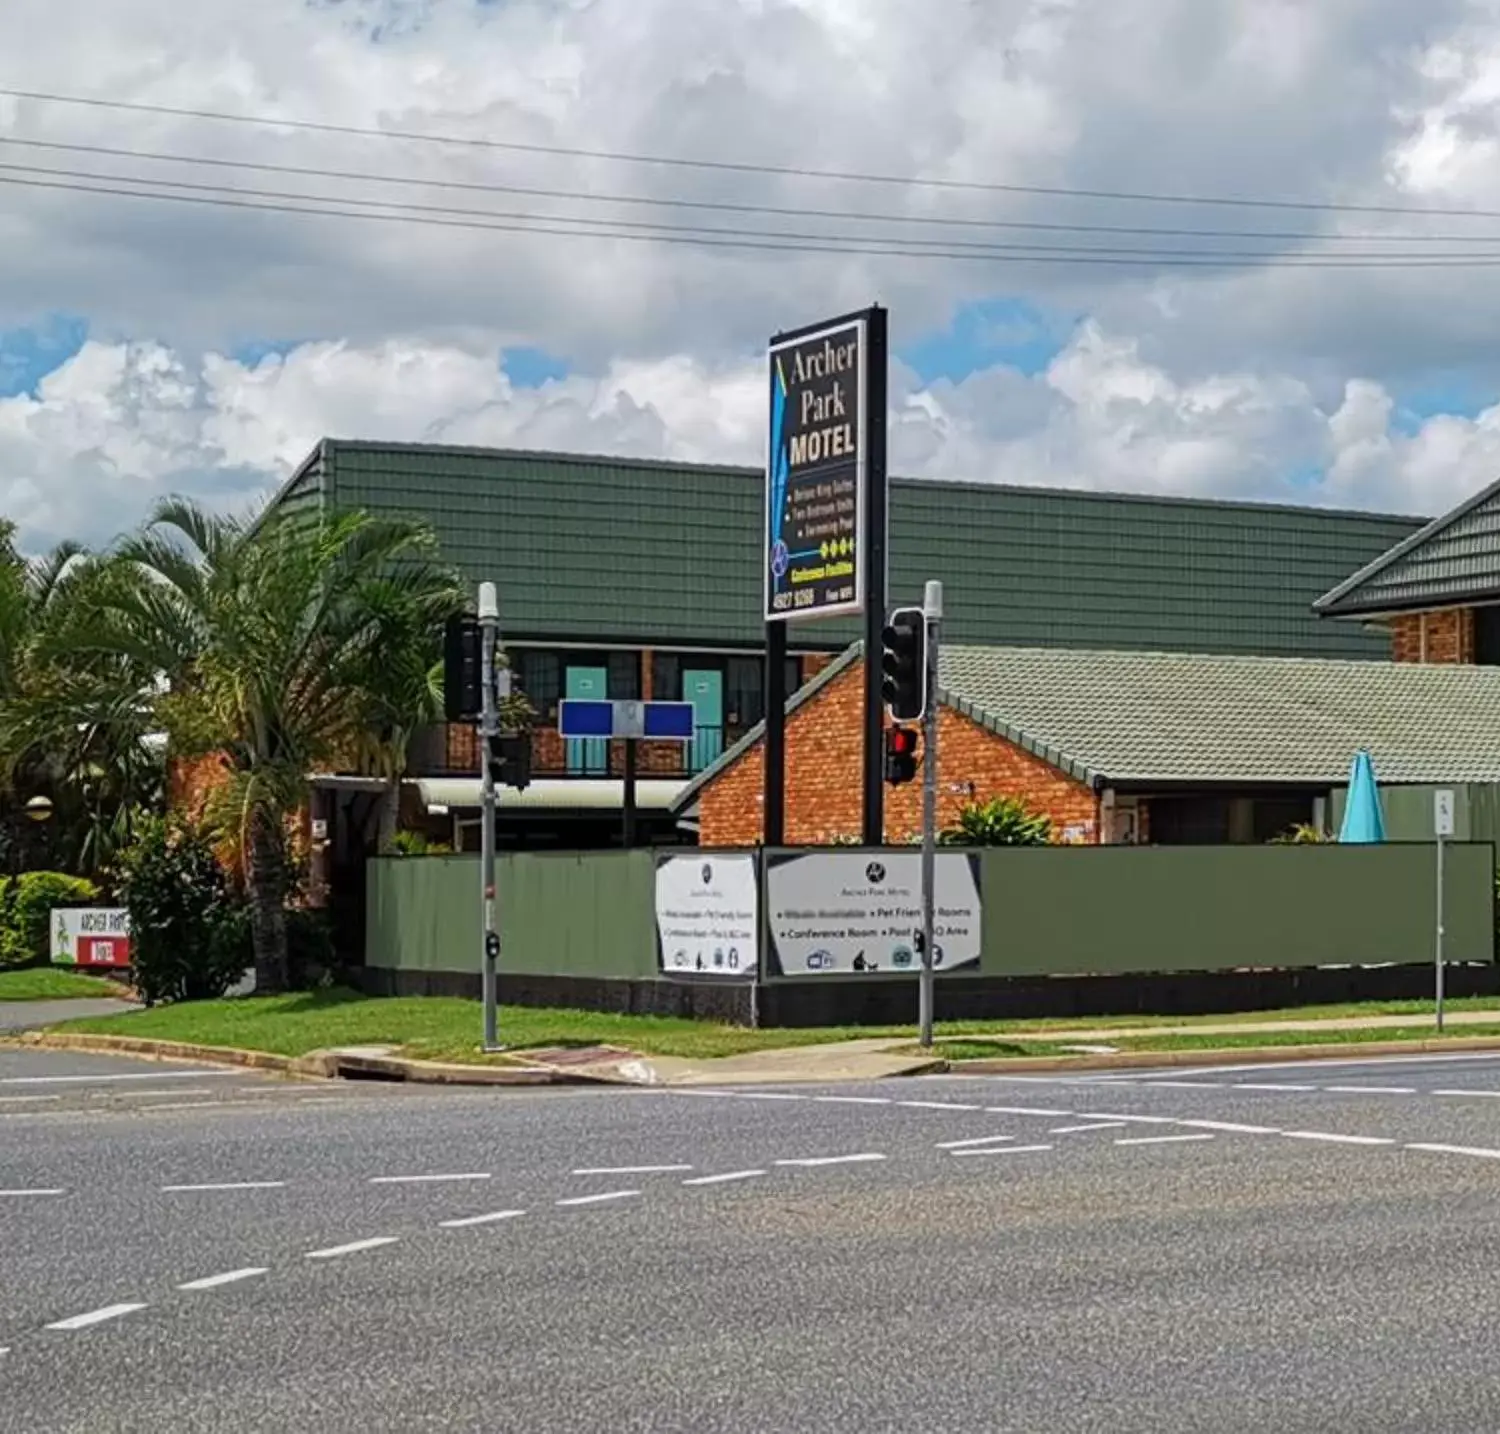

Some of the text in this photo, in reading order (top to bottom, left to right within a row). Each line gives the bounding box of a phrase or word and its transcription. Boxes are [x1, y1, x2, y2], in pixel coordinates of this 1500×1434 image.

[790, 339, 856, 385] Archer
[801, 381, 845, 425] Park
[790, 423, 855, 466] MOTEL
[787, 927, 845, 939] Conference
[847, 927, 877, 938] Room
[946, 927, 968, 936] Area
[877, 907, 893, 917] Pet
[938, 907, 971, 917] Rooms
